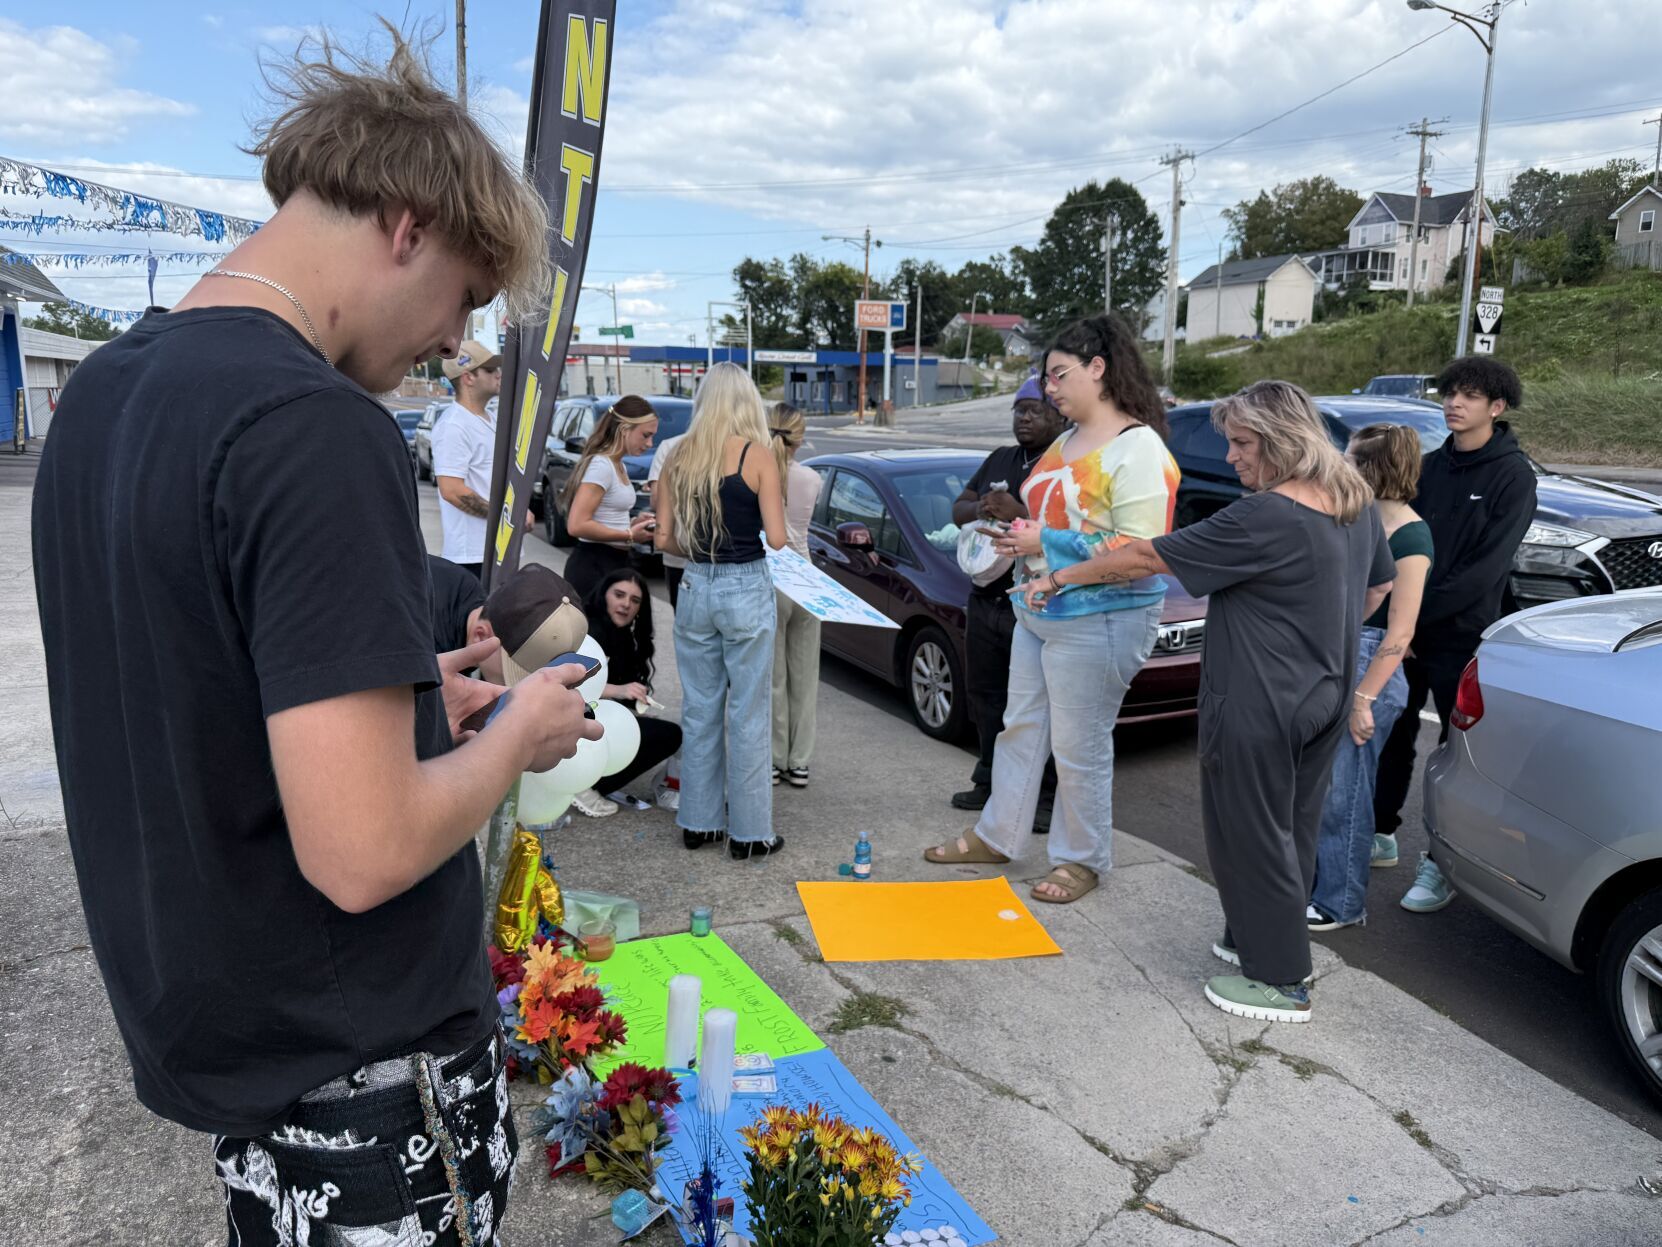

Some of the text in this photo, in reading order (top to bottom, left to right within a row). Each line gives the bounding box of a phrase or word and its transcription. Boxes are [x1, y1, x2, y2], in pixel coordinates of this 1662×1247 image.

[1481, 289, 1503, 299] NORTH
[862, 306, 884, 314] FORD
[1480, 305, 1498, 319] 328
[860, 314, 886, 323] TRUCKS
[756, 1013, 809, 1053] FROST
